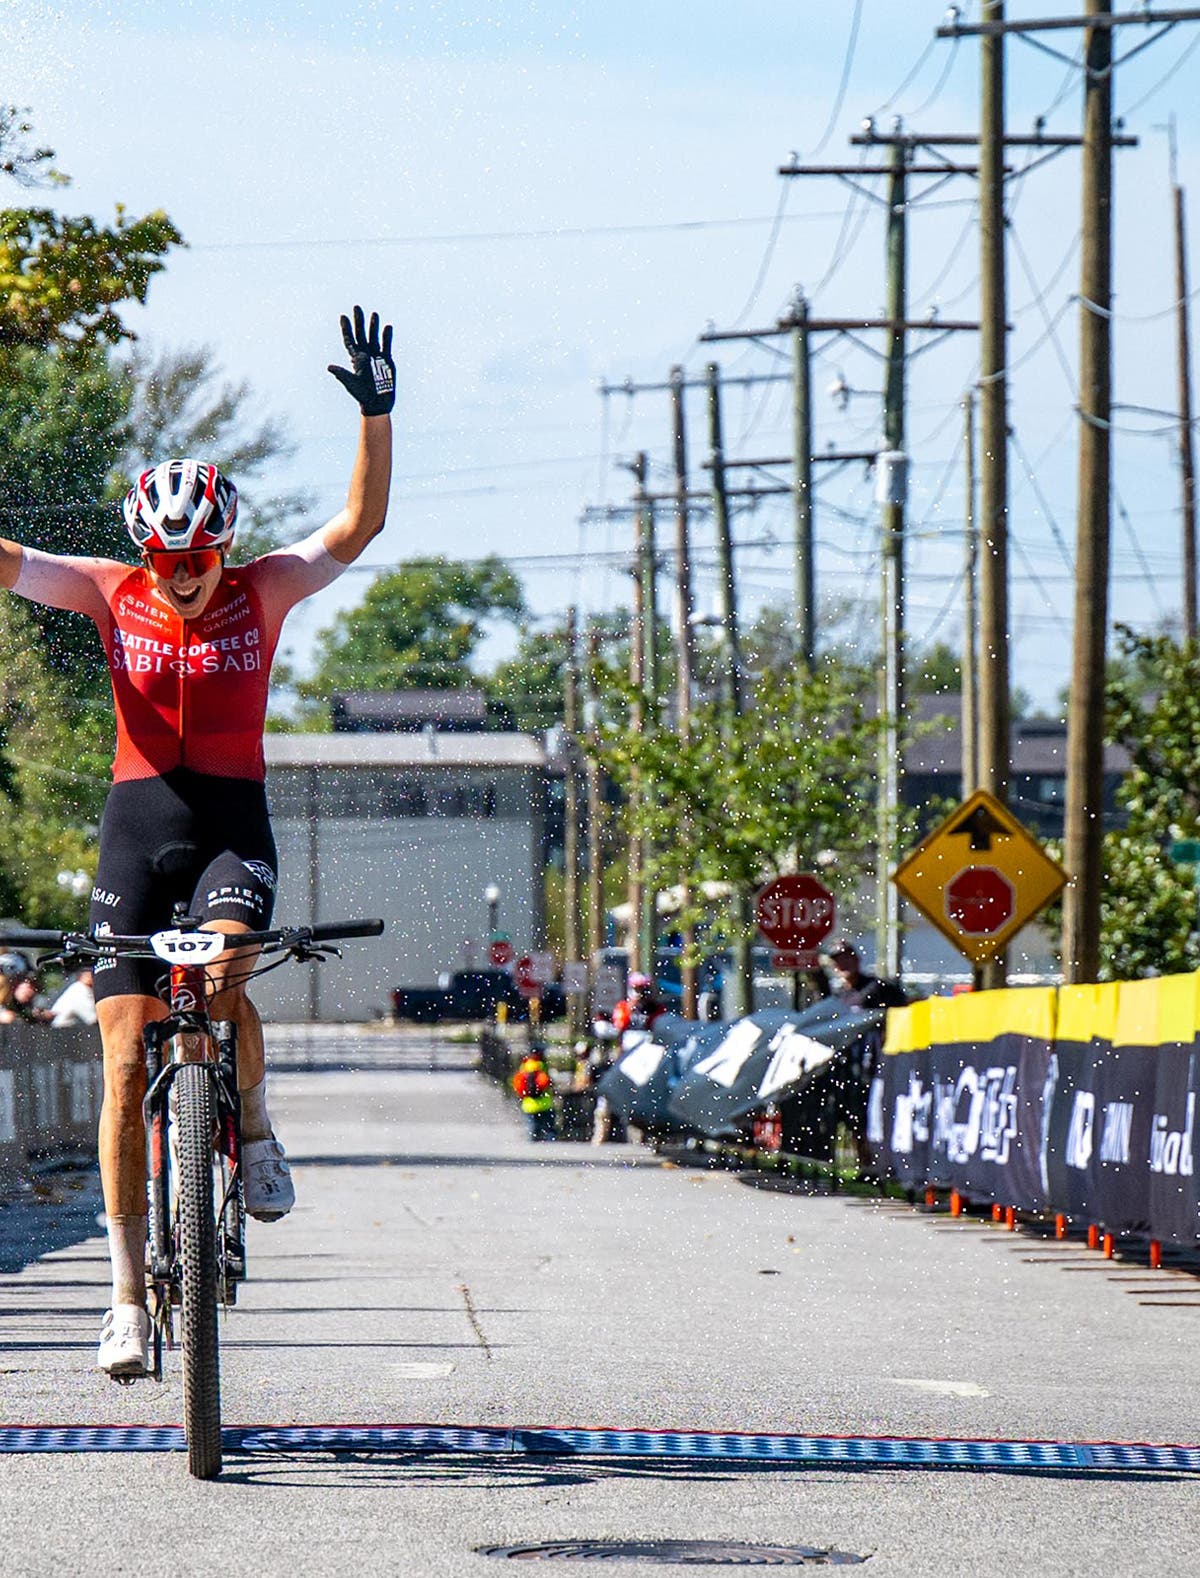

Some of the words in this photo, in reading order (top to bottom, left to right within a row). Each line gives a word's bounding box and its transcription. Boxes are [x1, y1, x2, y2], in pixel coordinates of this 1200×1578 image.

[125, 594, 169, 622] SPIER
[203, 606, 251, 632] GARMIN
[113, 627, 173, 656] SEATTLE
[178, 636, 241, 658] COFFEE
[113, 648, 163, 673] SABI
[202, 650, 261, 674] SABI
[761, 898, 830, 930] STOP
[164, 941, 213, 953] 107
